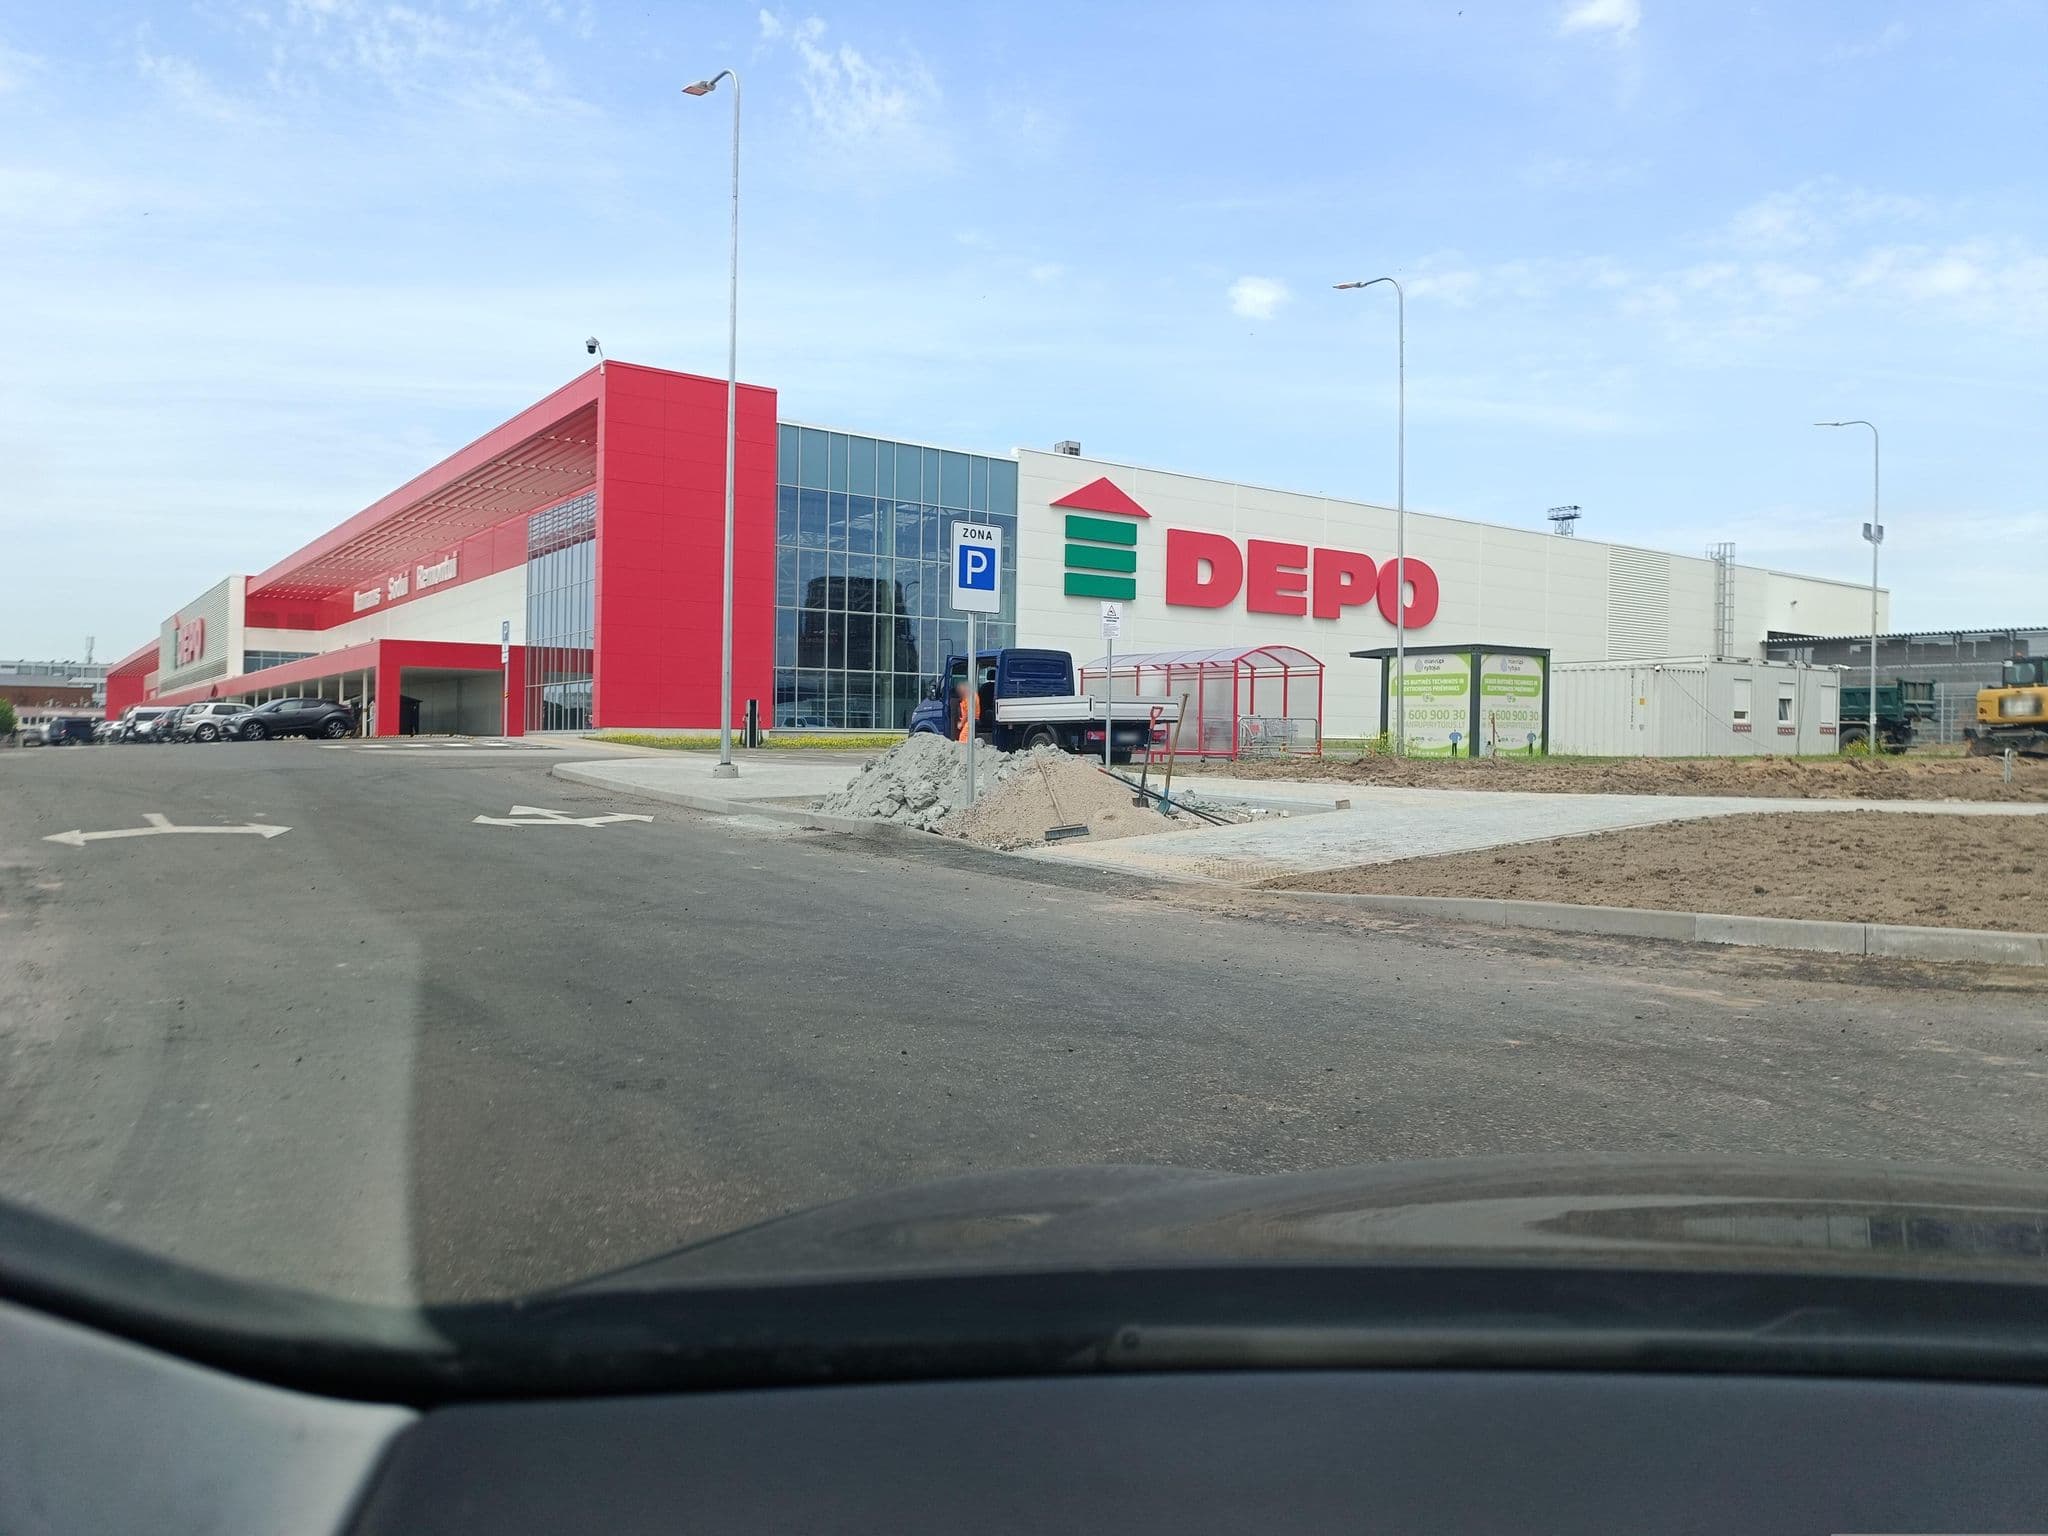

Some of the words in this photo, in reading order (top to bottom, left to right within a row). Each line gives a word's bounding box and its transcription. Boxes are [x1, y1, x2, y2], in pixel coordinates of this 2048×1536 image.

[962, 528, 993, 541] ZONA
[966, 550, 988, 585] P
[1166, 528, 1439, 629] DEPO
[1408, 710, 1428, 720] 600
[1430, 710, 1450, 720] 900
[1453, 709, 1466, 720] 30
[1495, 710, 1511, 721] 600
[1512, 710, 1527, 721] 900
[1529, 710, 1539, 721] 30
